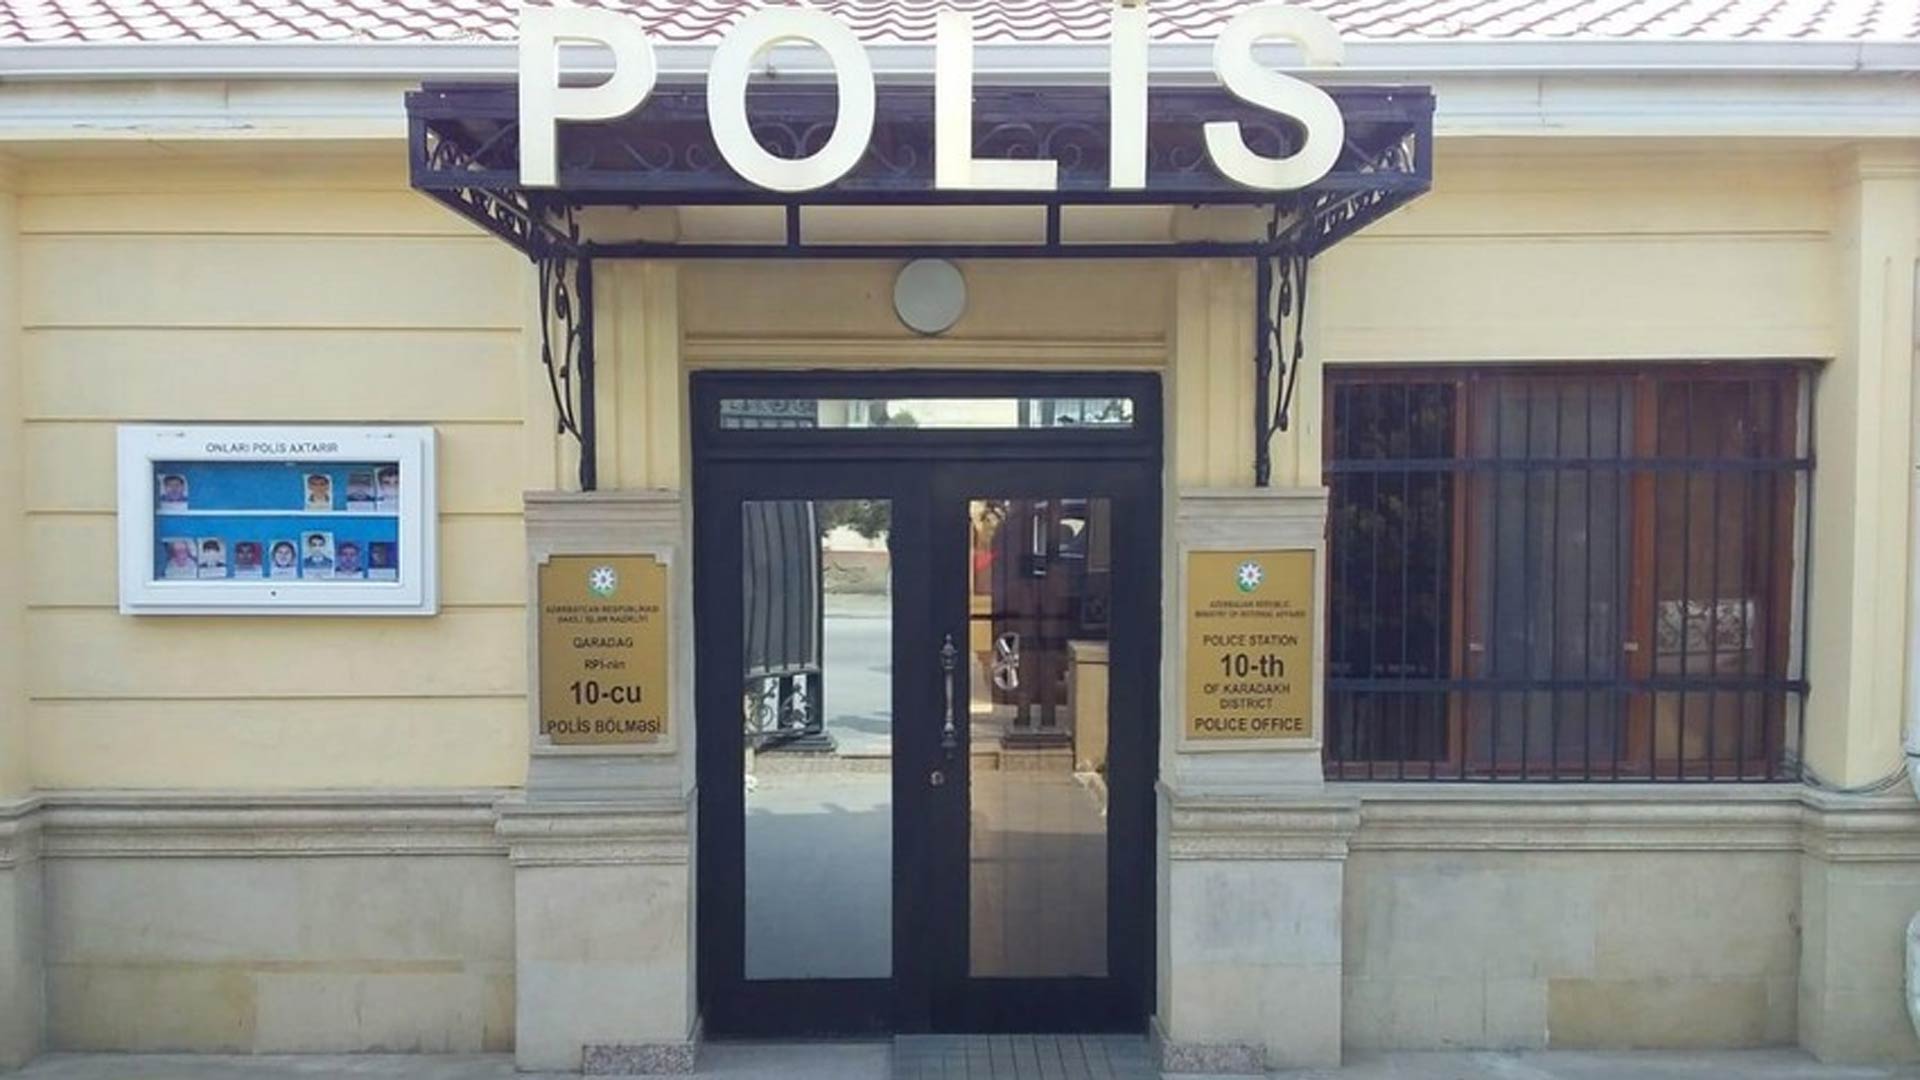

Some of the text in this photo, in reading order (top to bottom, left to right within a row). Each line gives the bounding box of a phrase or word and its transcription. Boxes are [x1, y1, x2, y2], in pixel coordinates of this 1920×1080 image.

[1203, 634, 1298, 646] POLICE STATION
[1221, 653, 1284, 678] 10-th
[570, 681, 642, 705] 10-cu
[1203, 683, 1290, 694] OF KARADAKH
[1220, 698, 1273, 710] DISTRICT
[1195, 718, 1303, 731] POLICE OFFICE
